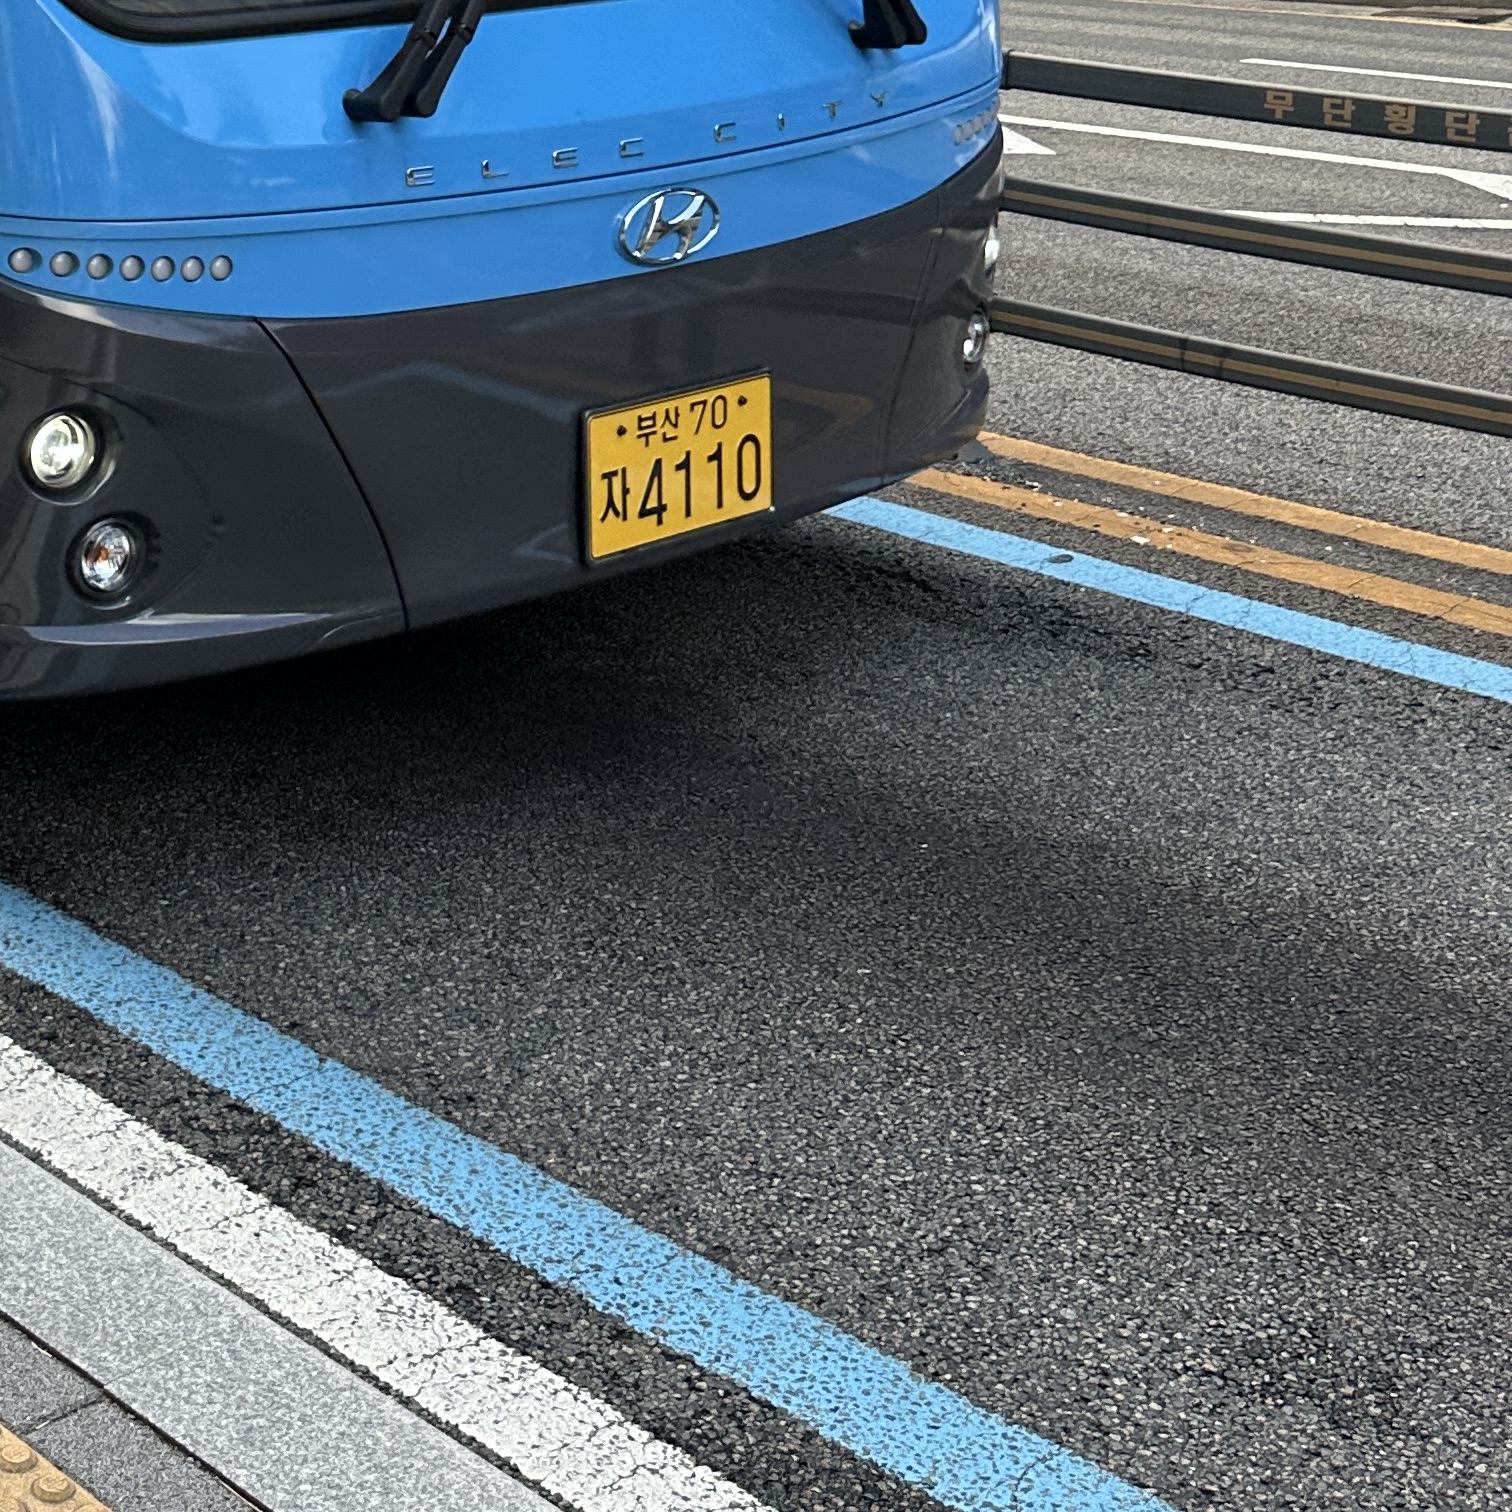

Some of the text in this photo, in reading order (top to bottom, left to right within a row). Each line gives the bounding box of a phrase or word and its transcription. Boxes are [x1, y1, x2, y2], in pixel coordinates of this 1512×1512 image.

[405, 90, 890, 188] ELEC CITY
[635, 395, 728, 445] 부산 70
